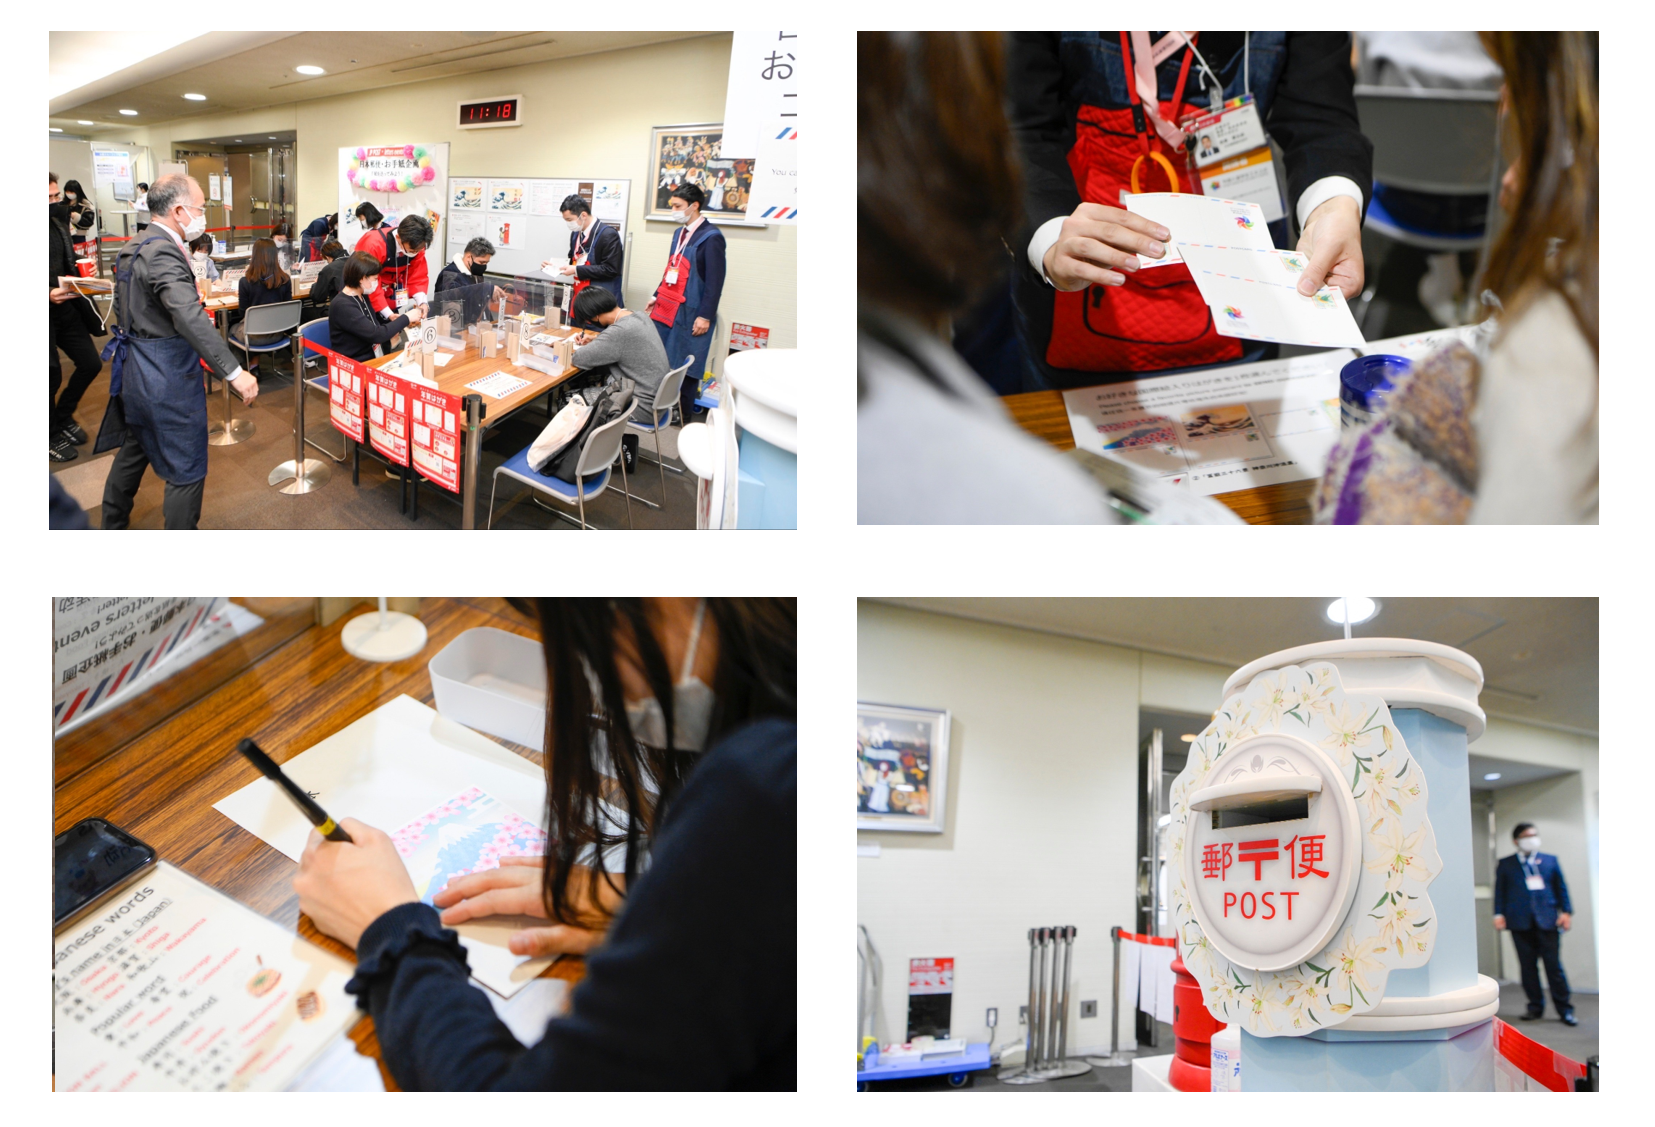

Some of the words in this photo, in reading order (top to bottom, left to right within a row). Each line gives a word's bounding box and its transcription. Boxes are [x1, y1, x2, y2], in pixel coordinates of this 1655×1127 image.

[470, 103, 511, 120] 11:18
[772, 168, 787, 176] You
[1224, 891, 1299, 920] POST
[55, 925, 105, 964] anese
[105, 886, 154, 923] words
